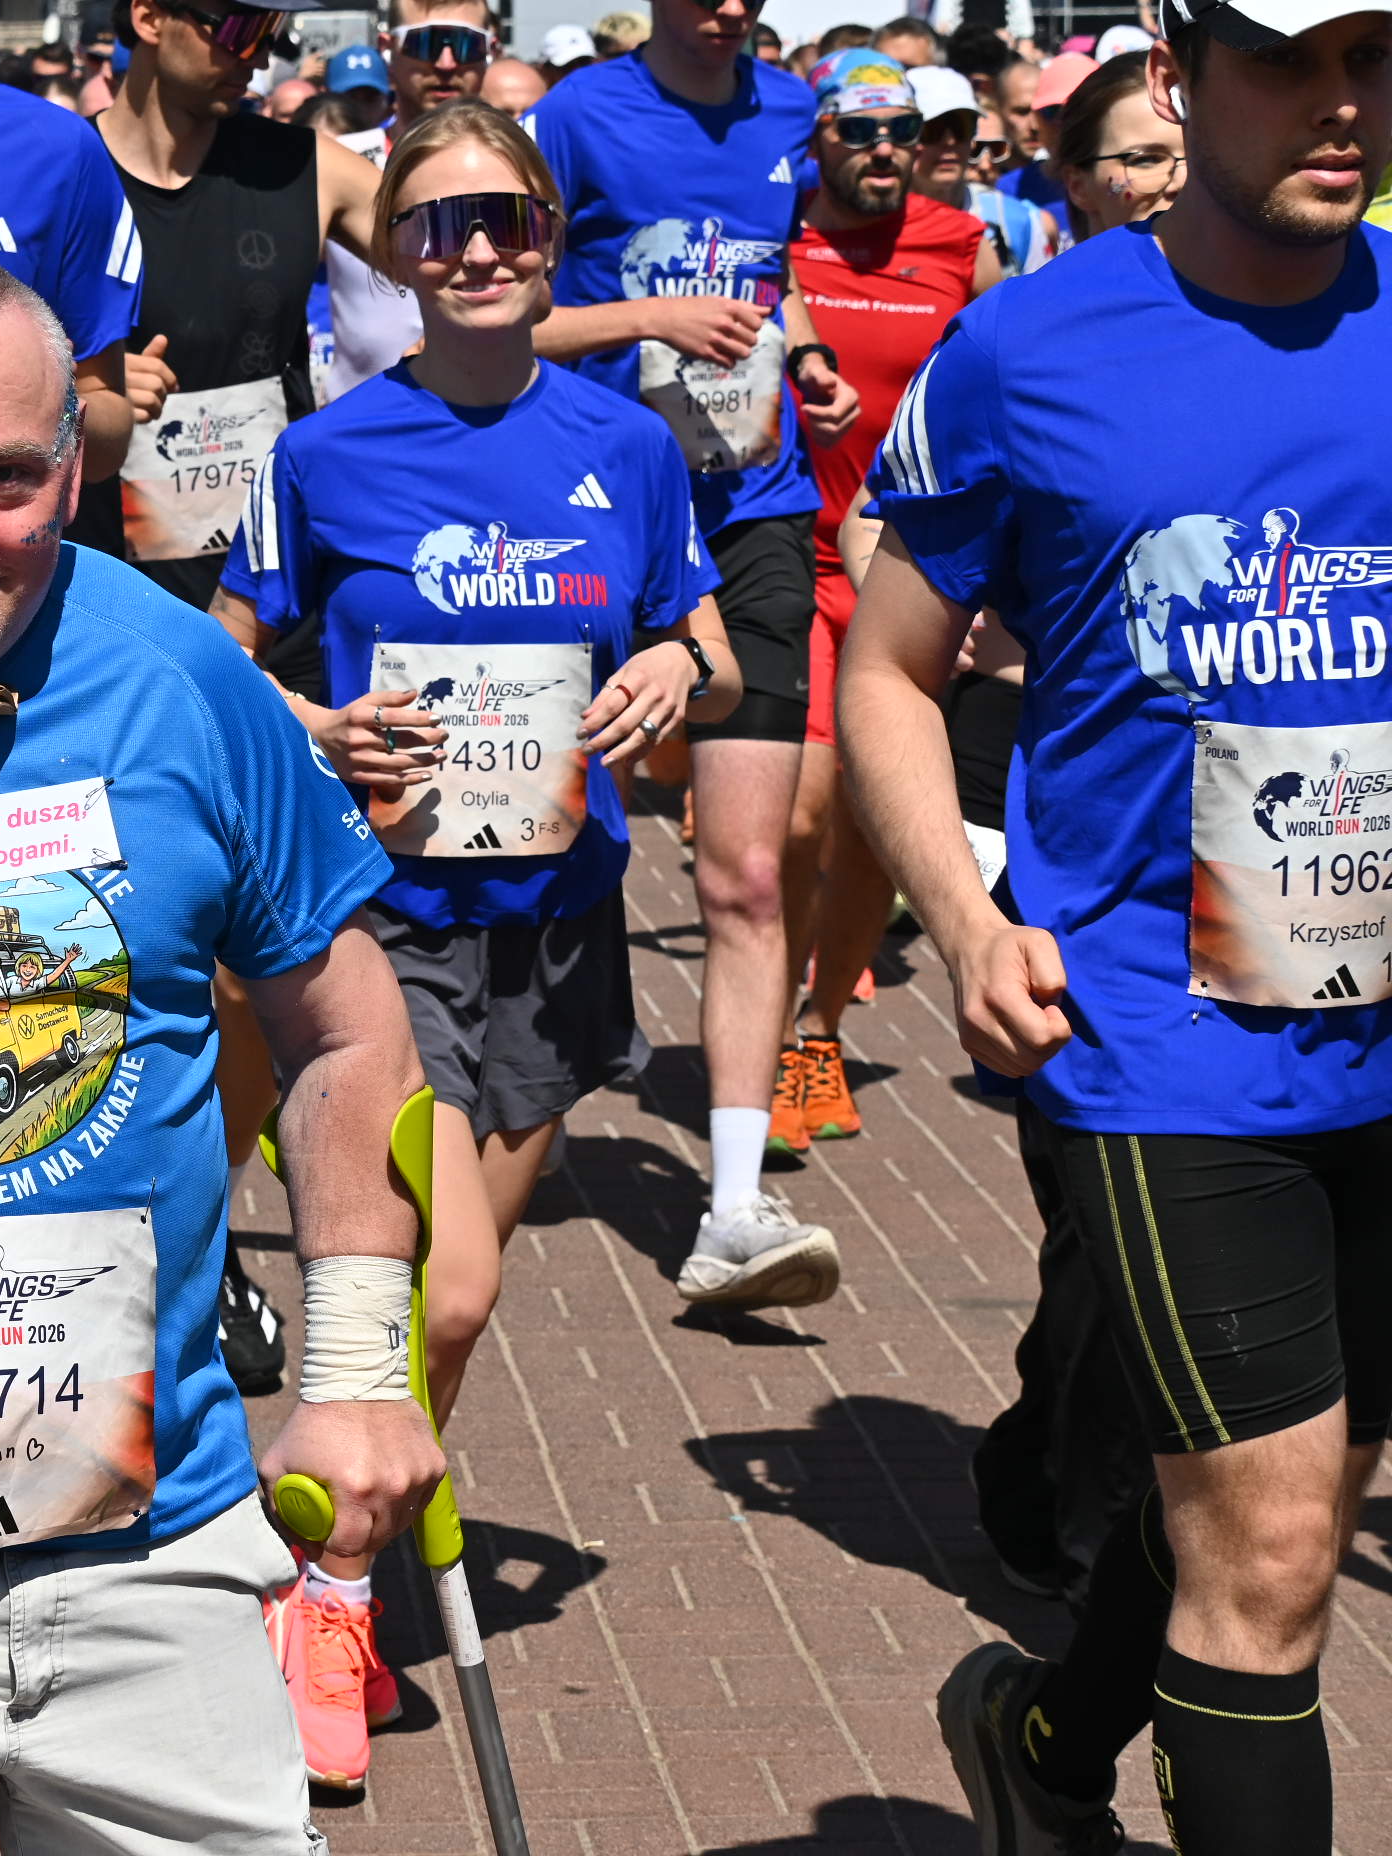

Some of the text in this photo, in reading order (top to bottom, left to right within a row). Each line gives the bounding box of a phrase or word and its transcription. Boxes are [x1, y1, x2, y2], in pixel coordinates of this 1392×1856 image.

[687, 242, 754, 261] WINGS
[696, 261, 738, 278] LIFE
[683, 388, 752, 416] 10981
[187, 414, 238, 434] WINGS
[170, 458, 256, 494] 17975
[473, 541, 546, 560] WINGS
[471, 558, 528, 574] FOR LIFE
[1232, 551, 1372, 586] WINGS
[1227, 585, 1334, 617] FOR LIFE
[1180, 615, 1388, 687] WORLD
[380, 661, 406, 671] POLAND
[460, 681, 525, 698] WINGS
[467, 697, 506, 712] LIFE
[504, 714, 529, 727] 2026
[1205, 747, 1239, 761] POLAND
[1310, 773, 1387, 798] WINGS
[461, 790, 510, 810] Otylia
[1303, 796, 1365, 817] FOR LIFE
[7, 800, 89, 829] duszą,
[1363, 814, 1391, 833] 2026
[520, 817, 560, 842] 3 F-S
[1290, 915, 1387, 947] Krzysztof
[35, 1004, 69, 1021] Samochody
[38, 1014, 69, 1031] Dostawcze
[39, 1147, 85, 1187] NA
[76, 1052, 146, 1160] ZAKAZIE
[28, 1323, 66, 1344] 2026
